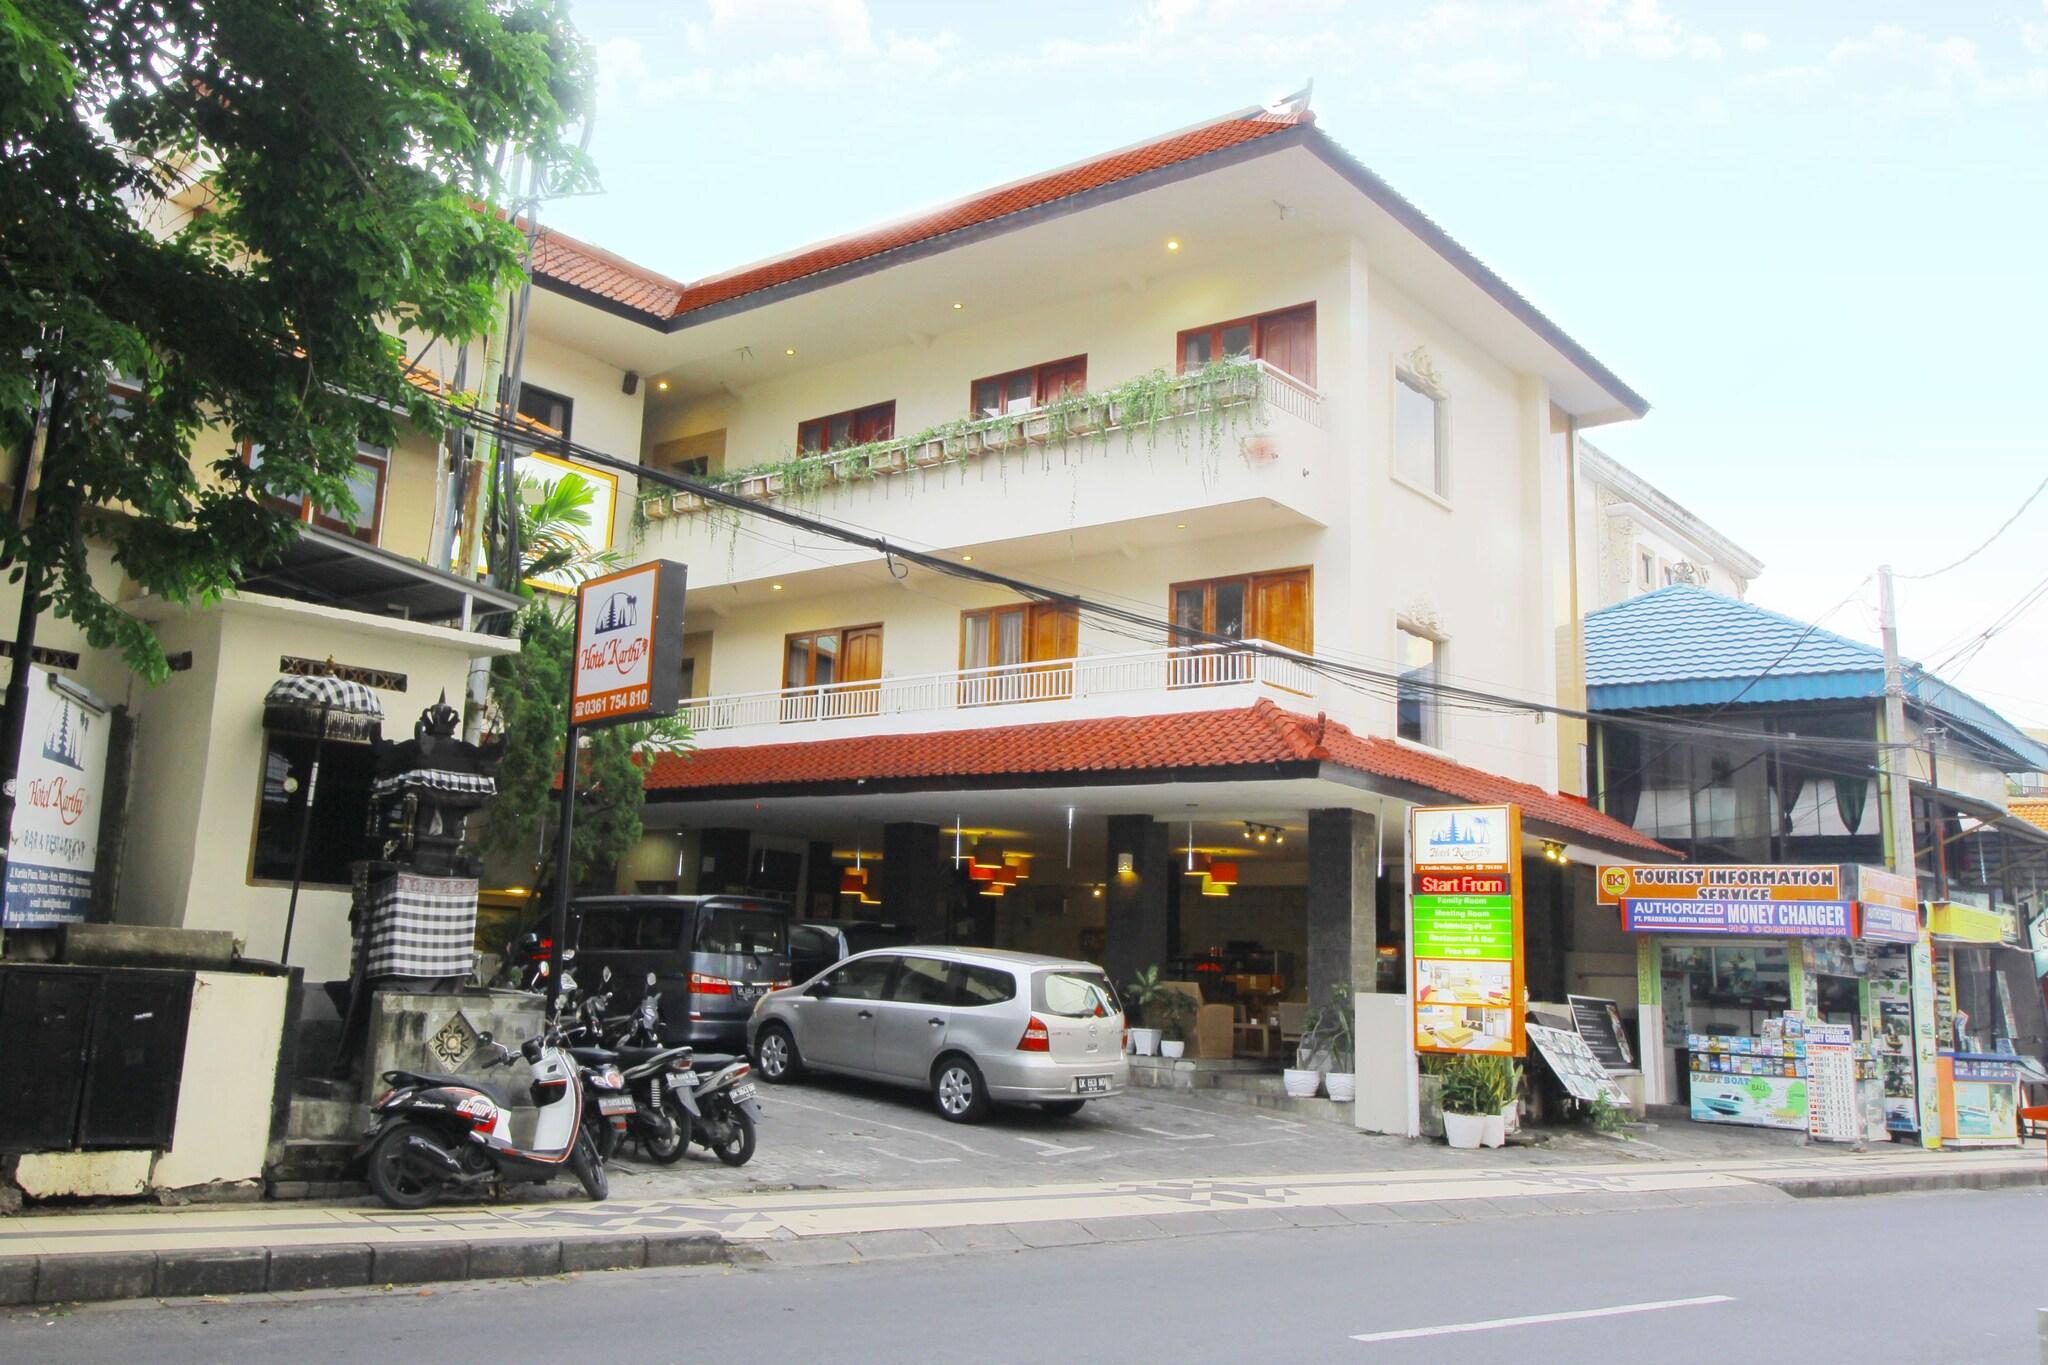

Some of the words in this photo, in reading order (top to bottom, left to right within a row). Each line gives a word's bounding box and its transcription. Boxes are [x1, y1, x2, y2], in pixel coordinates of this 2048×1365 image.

[580, 642, 609, 671] Hotel
[585, 696, 606, 716] 0361
[609, 692, 627, 711] 754
[629, 688, 648, 707] 810
[28, 778, 56, 808] Hotel
[1422, 876, 1460, 892] Start
[1462, 876, 1503, 892] From
[1633, 869, 1704, 885] TOURIST
[1708, 869, 1834, 886] INFORMATION
[1463, 896, 1487, 905] Room
[1697, 887, 1770, 900] SERVICE
[1467, 910, 1490, 918] Room
[1634, 902, 1724, 915] AUTHORIZED
[1727, 903, 1775, 925] MONEY
[1778, 905, 1845, 926] CHANGER
[1728, 925, 1749, 933] NO
[1752, 925, 1846, 936] COMMISSION
[1723, 1077, 1750, 1085] BOAT
